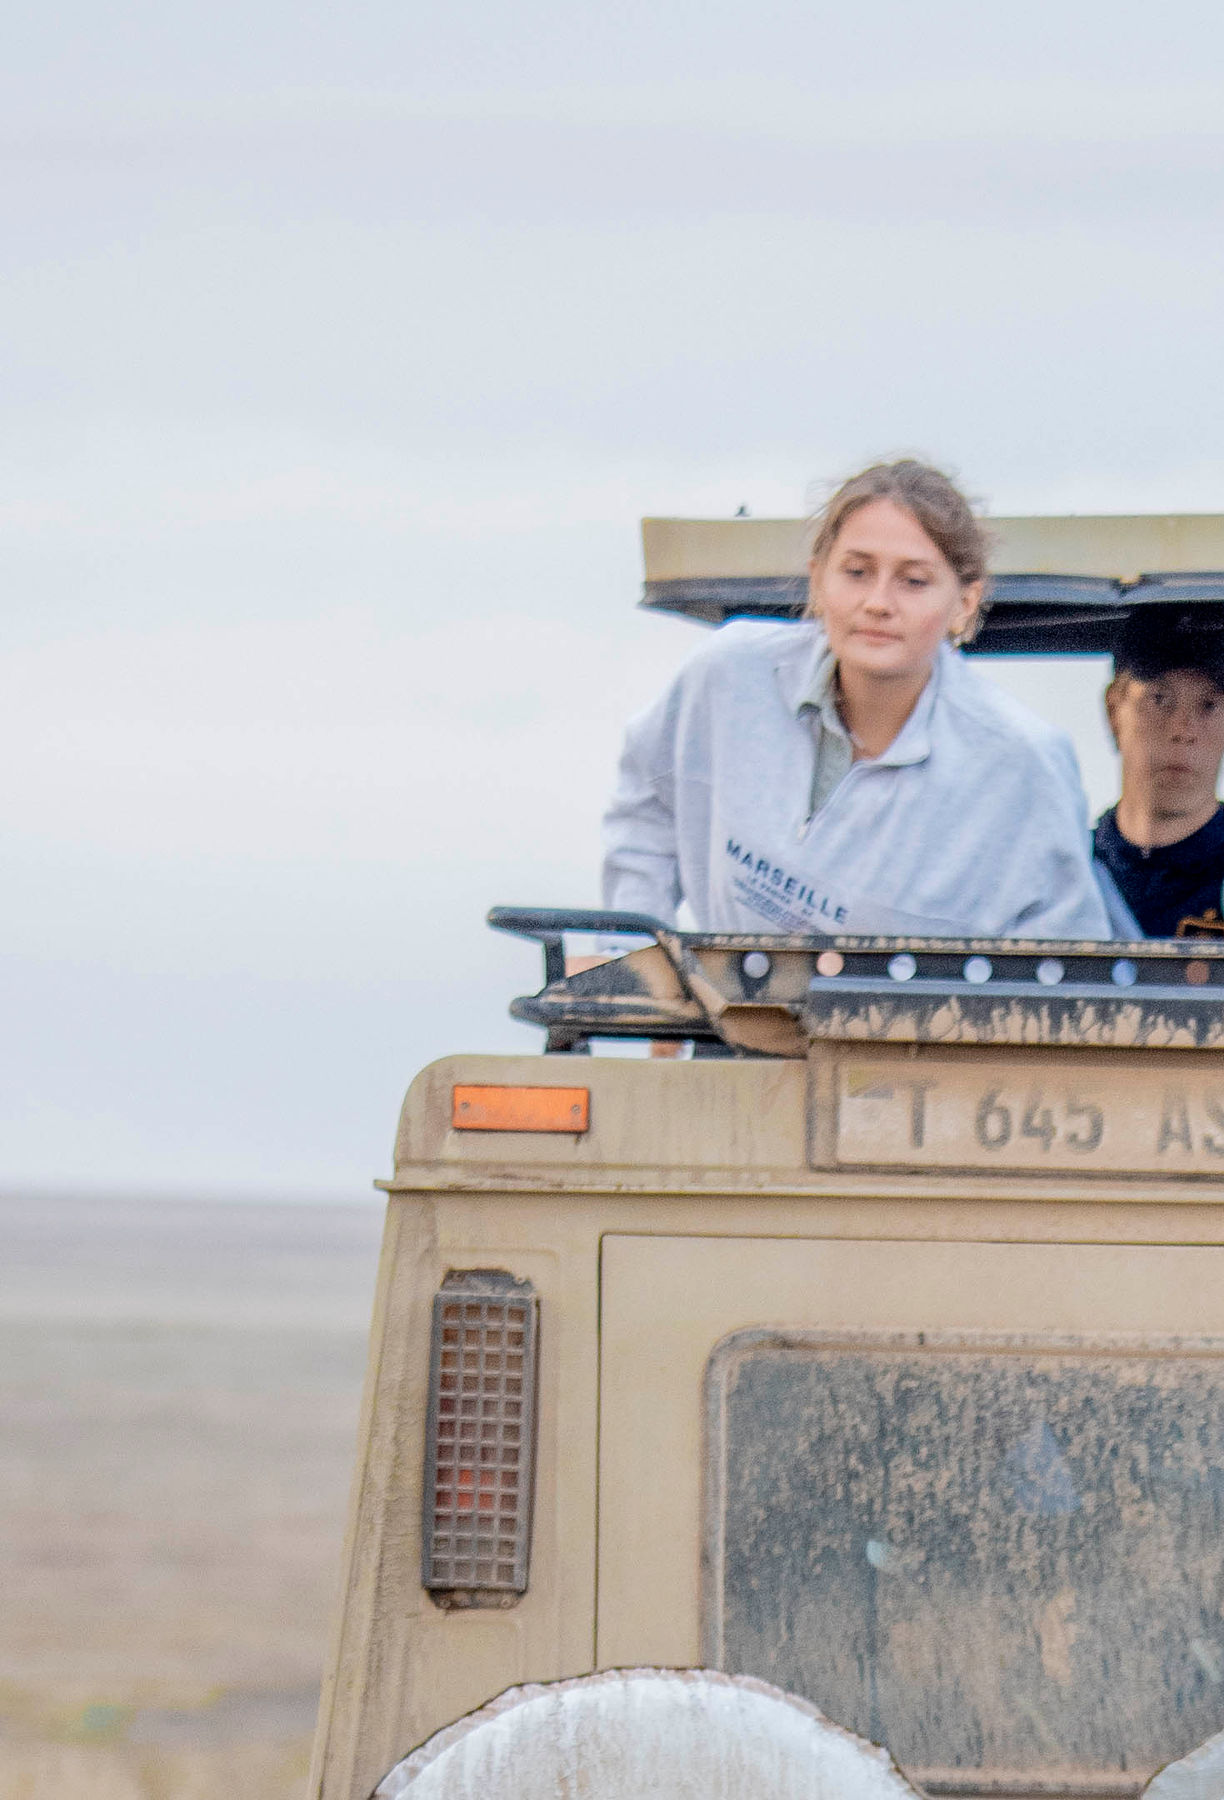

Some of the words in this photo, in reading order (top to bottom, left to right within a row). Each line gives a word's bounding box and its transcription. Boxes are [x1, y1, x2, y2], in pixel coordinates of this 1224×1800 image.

[725, 839, 849, 924] MARSEILLE
[901, 1079, 934, 1149] T
[974, 1080, 1105, 1154] 645
